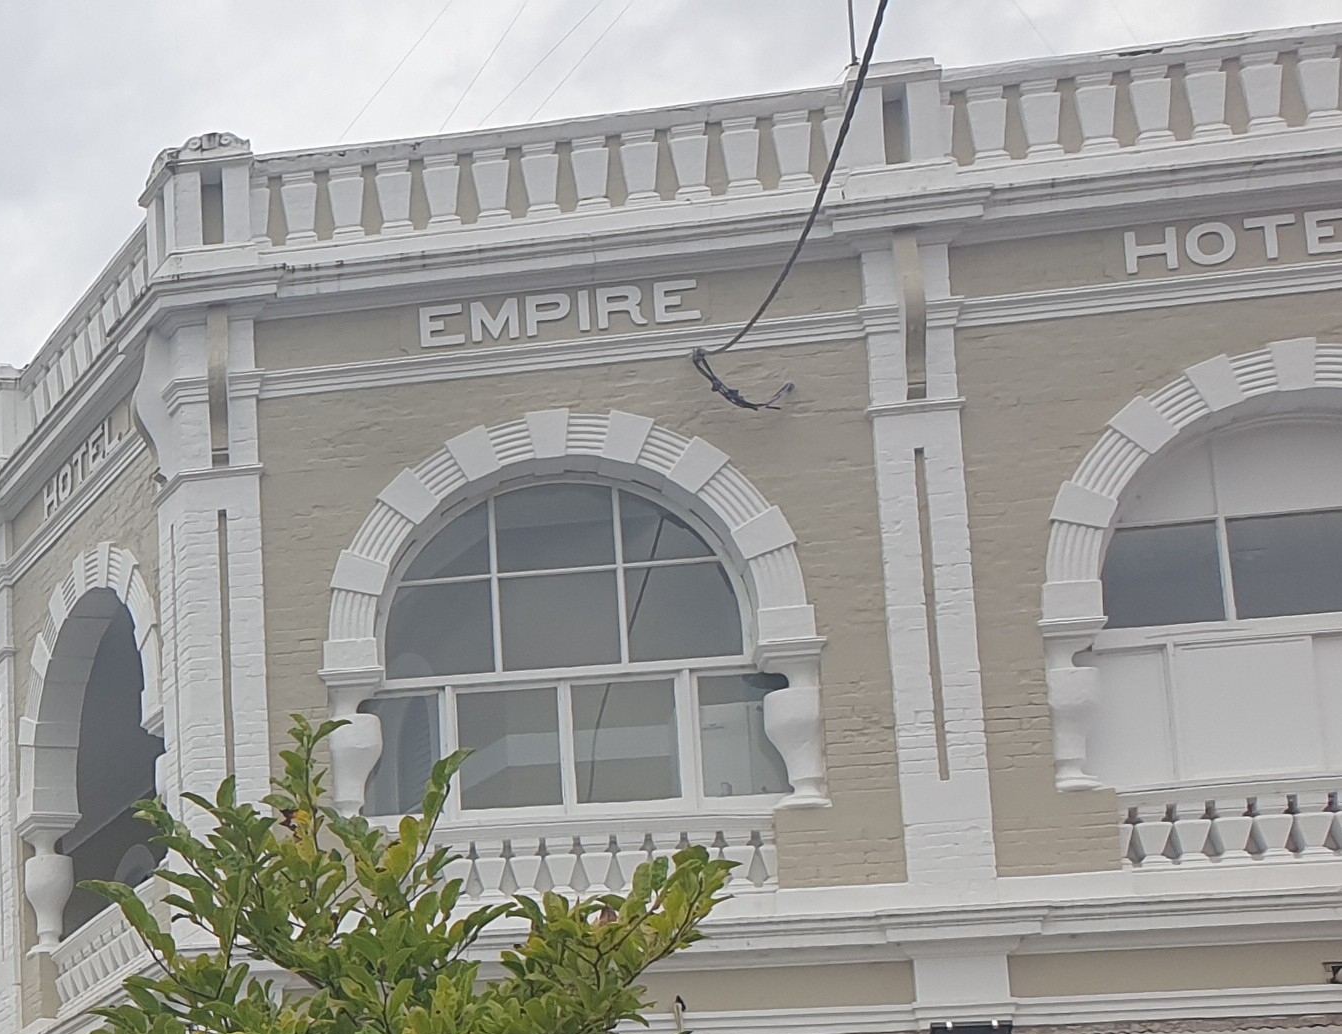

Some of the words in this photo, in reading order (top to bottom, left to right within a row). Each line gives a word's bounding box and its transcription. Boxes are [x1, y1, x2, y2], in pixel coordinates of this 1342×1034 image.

[419, 279, 702, 348] EMPIRE
[1124, 209, 1342, 274] HOTE
[43, 418, 119, 520] HOTEL
